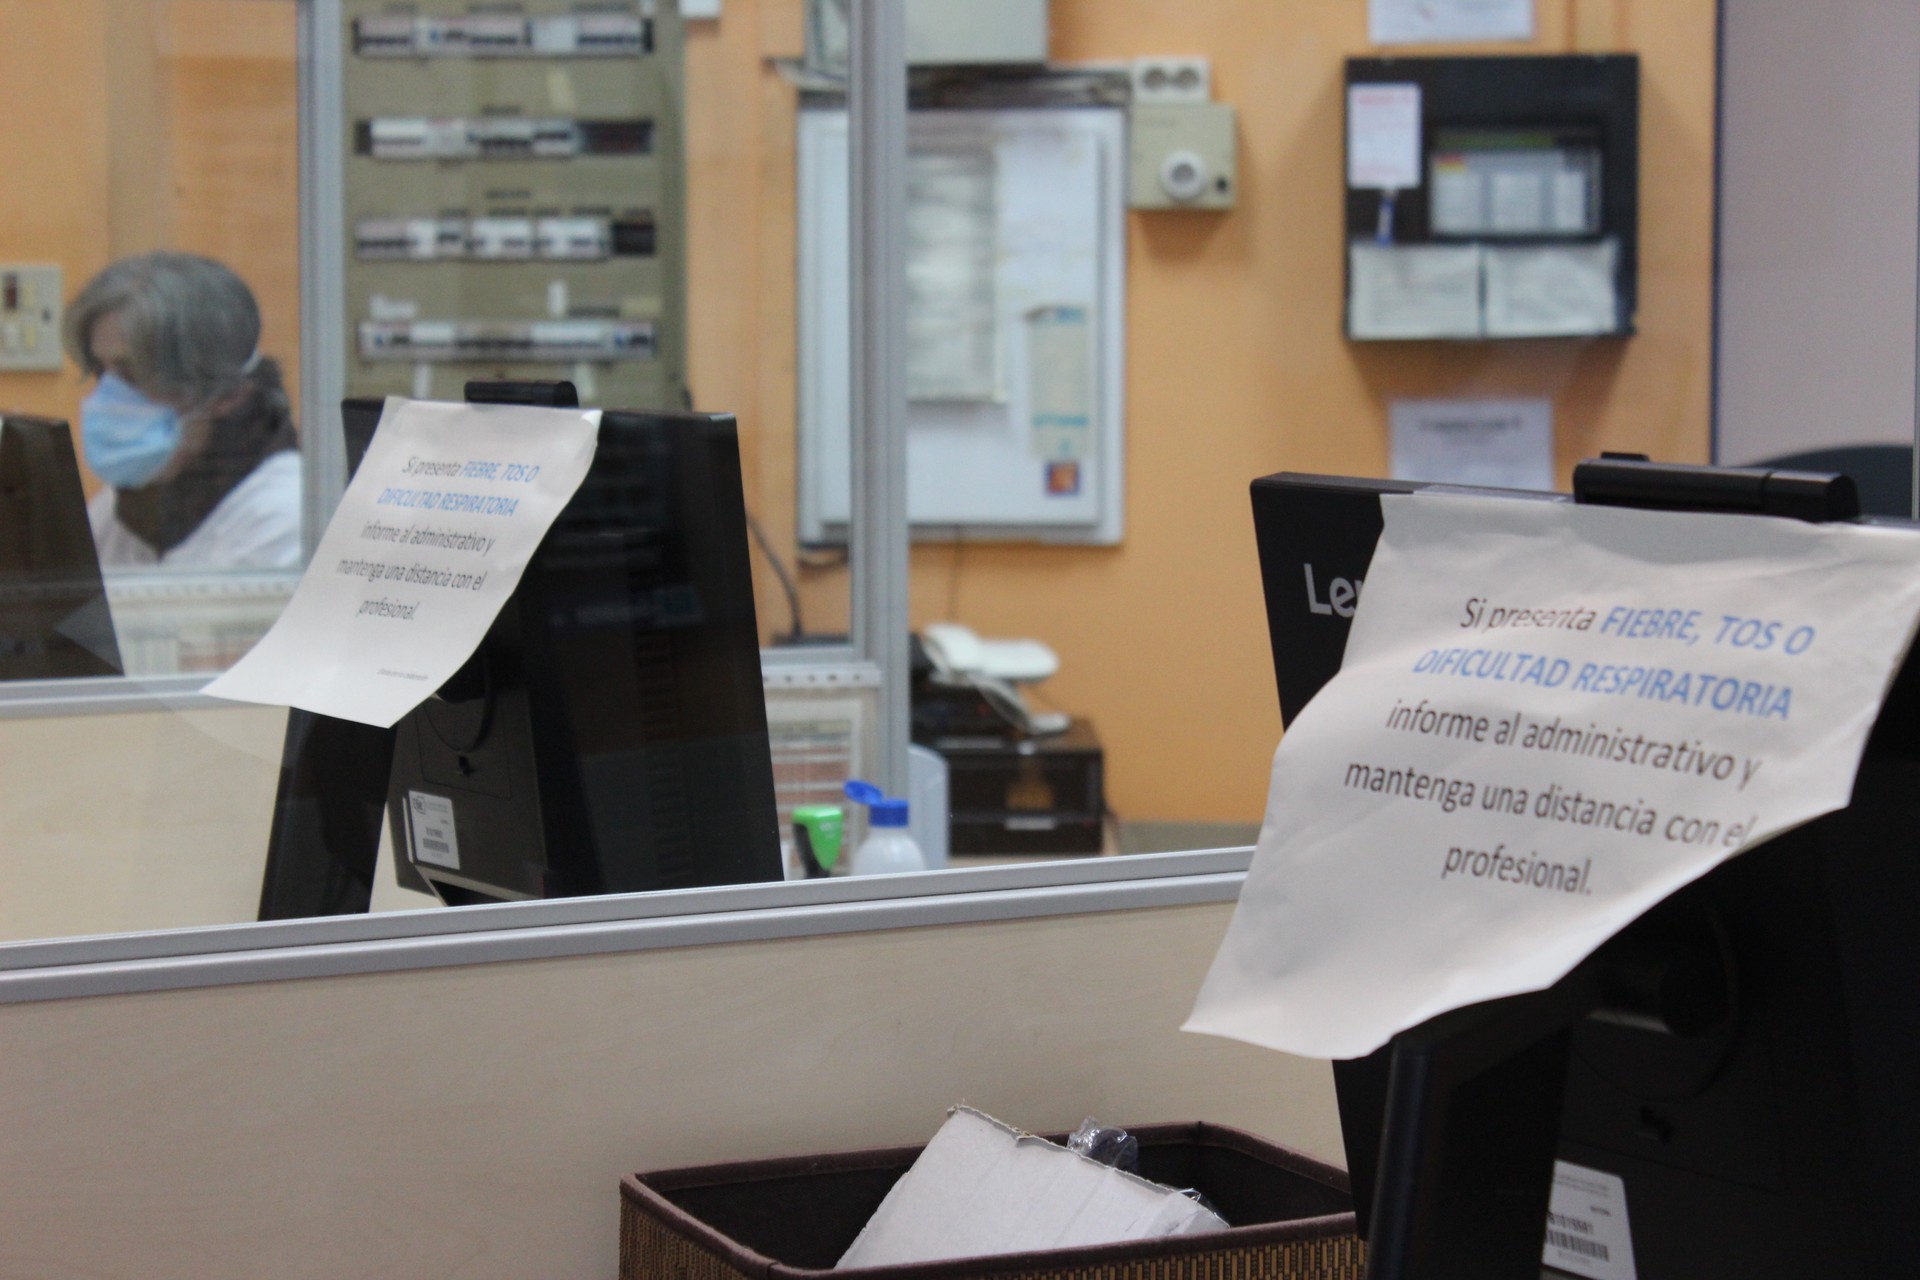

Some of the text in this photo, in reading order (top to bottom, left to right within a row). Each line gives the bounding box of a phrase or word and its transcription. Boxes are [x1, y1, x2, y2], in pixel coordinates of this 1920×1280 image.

[402, 456, 420, 473] Si
[411, 461, 461, 477] presenta
[501, 463, 529, 481] TOS
[525, 464, 541, 483] O
[378, 487, 519, 517] DIFICULTAD RESPIRATORIA
[361, 520, 496, 557] informe al administrativo y
[337, 559, 488, 591] mantenga una distancia con el
[1460, 597, 1816, 656] Si presenta FIEBRE, TOS O
[1412, 647, 1793, 720] DIFICULTAD RESPIRATORIA
[1386, 698, 1763, 792] informe al administrativo y
[1344, 762, 1758, 848] mantenga una distancia con el
[1440, 842, 1593, 896] profesional.
